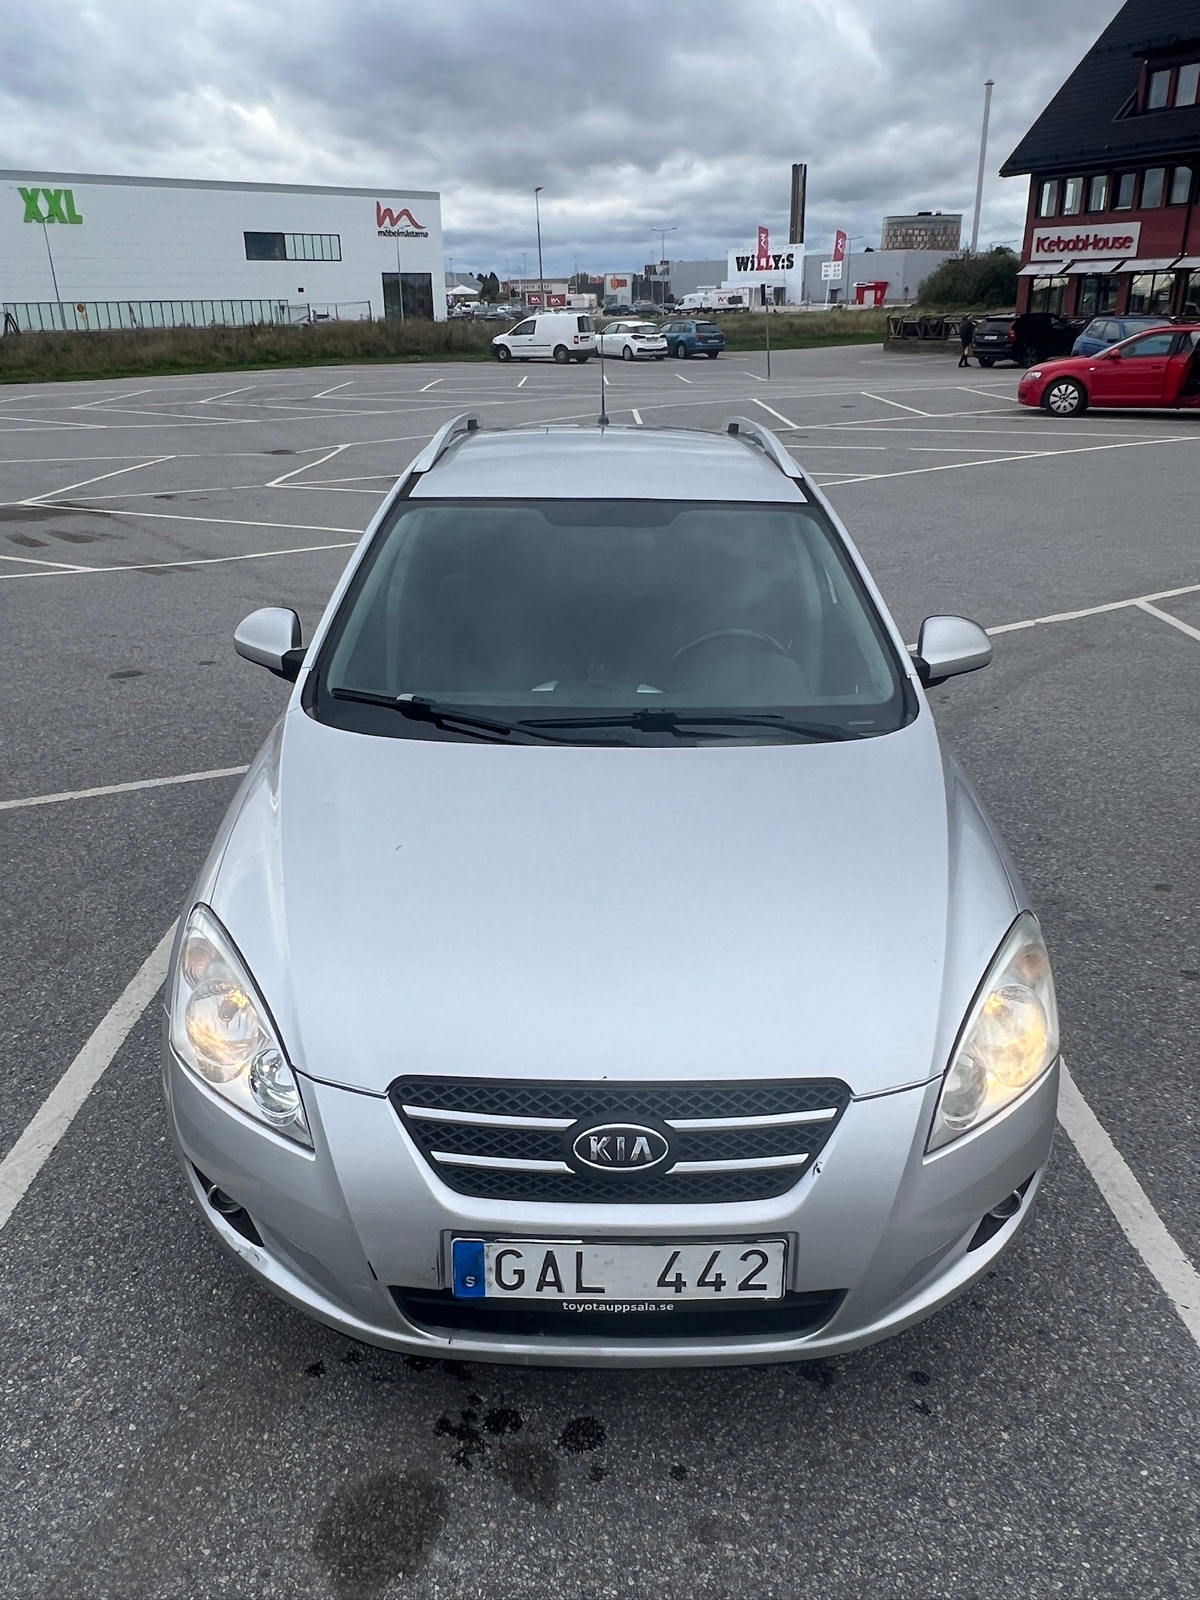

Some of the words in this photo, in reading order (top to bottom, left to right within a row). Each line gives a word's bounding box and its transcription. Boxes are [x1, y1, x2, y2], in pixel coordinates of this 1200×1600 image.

[18, 187, 83, 224] XXL
[1036, 234, 1134, 253] KebabHouse
[588, 1136, 654, 1161] KIA
[465, 1275, 476, 1288] S
[494, 1249, 606, 1294] GAL
[656, 1250, 770, 1294] 442
[562, 1301, 675, 1313] toyotauppsala.se
